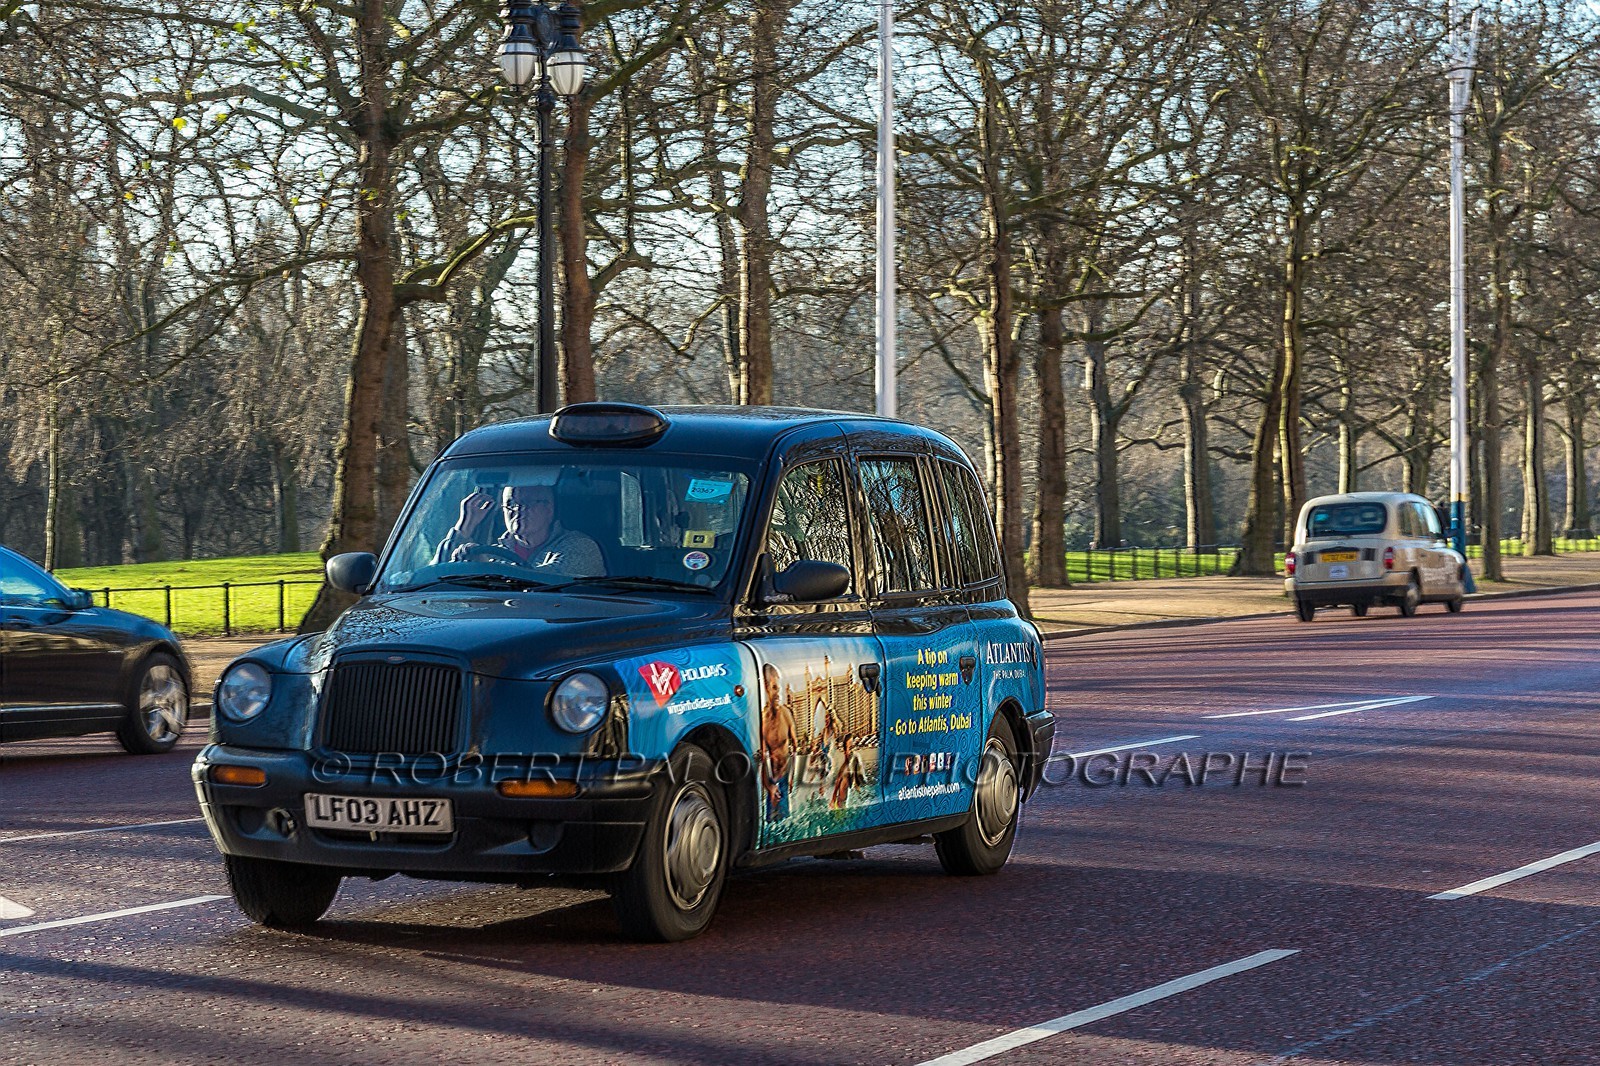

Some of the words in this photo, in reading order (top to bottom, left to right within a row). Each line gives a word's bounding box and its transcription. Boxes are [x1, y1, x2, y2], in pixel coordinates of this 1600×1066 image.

[917, 649, 924, 665] A
[925, 648, 936, 667] tip
[938, 651, 948, 663] on
[986, 640, 1031, 664] ATLANTIS
[681, 663, 726, 682] HOLIDAYS
[906, 672, 937, 691] keeping
[939, 672, 959, 687] warm
[913, 695, 928, 711] this
[929, 694, 953, 709] winter
[895, 719, 907, 735] Go
[908, 718, 917, 734] to
[918, 713, 949, 733] Atlantis,
[950, 712, 972, 730] Dubai
[314, 796, 379, 824] LF03
[387, 800, 440, 826] AHZ
